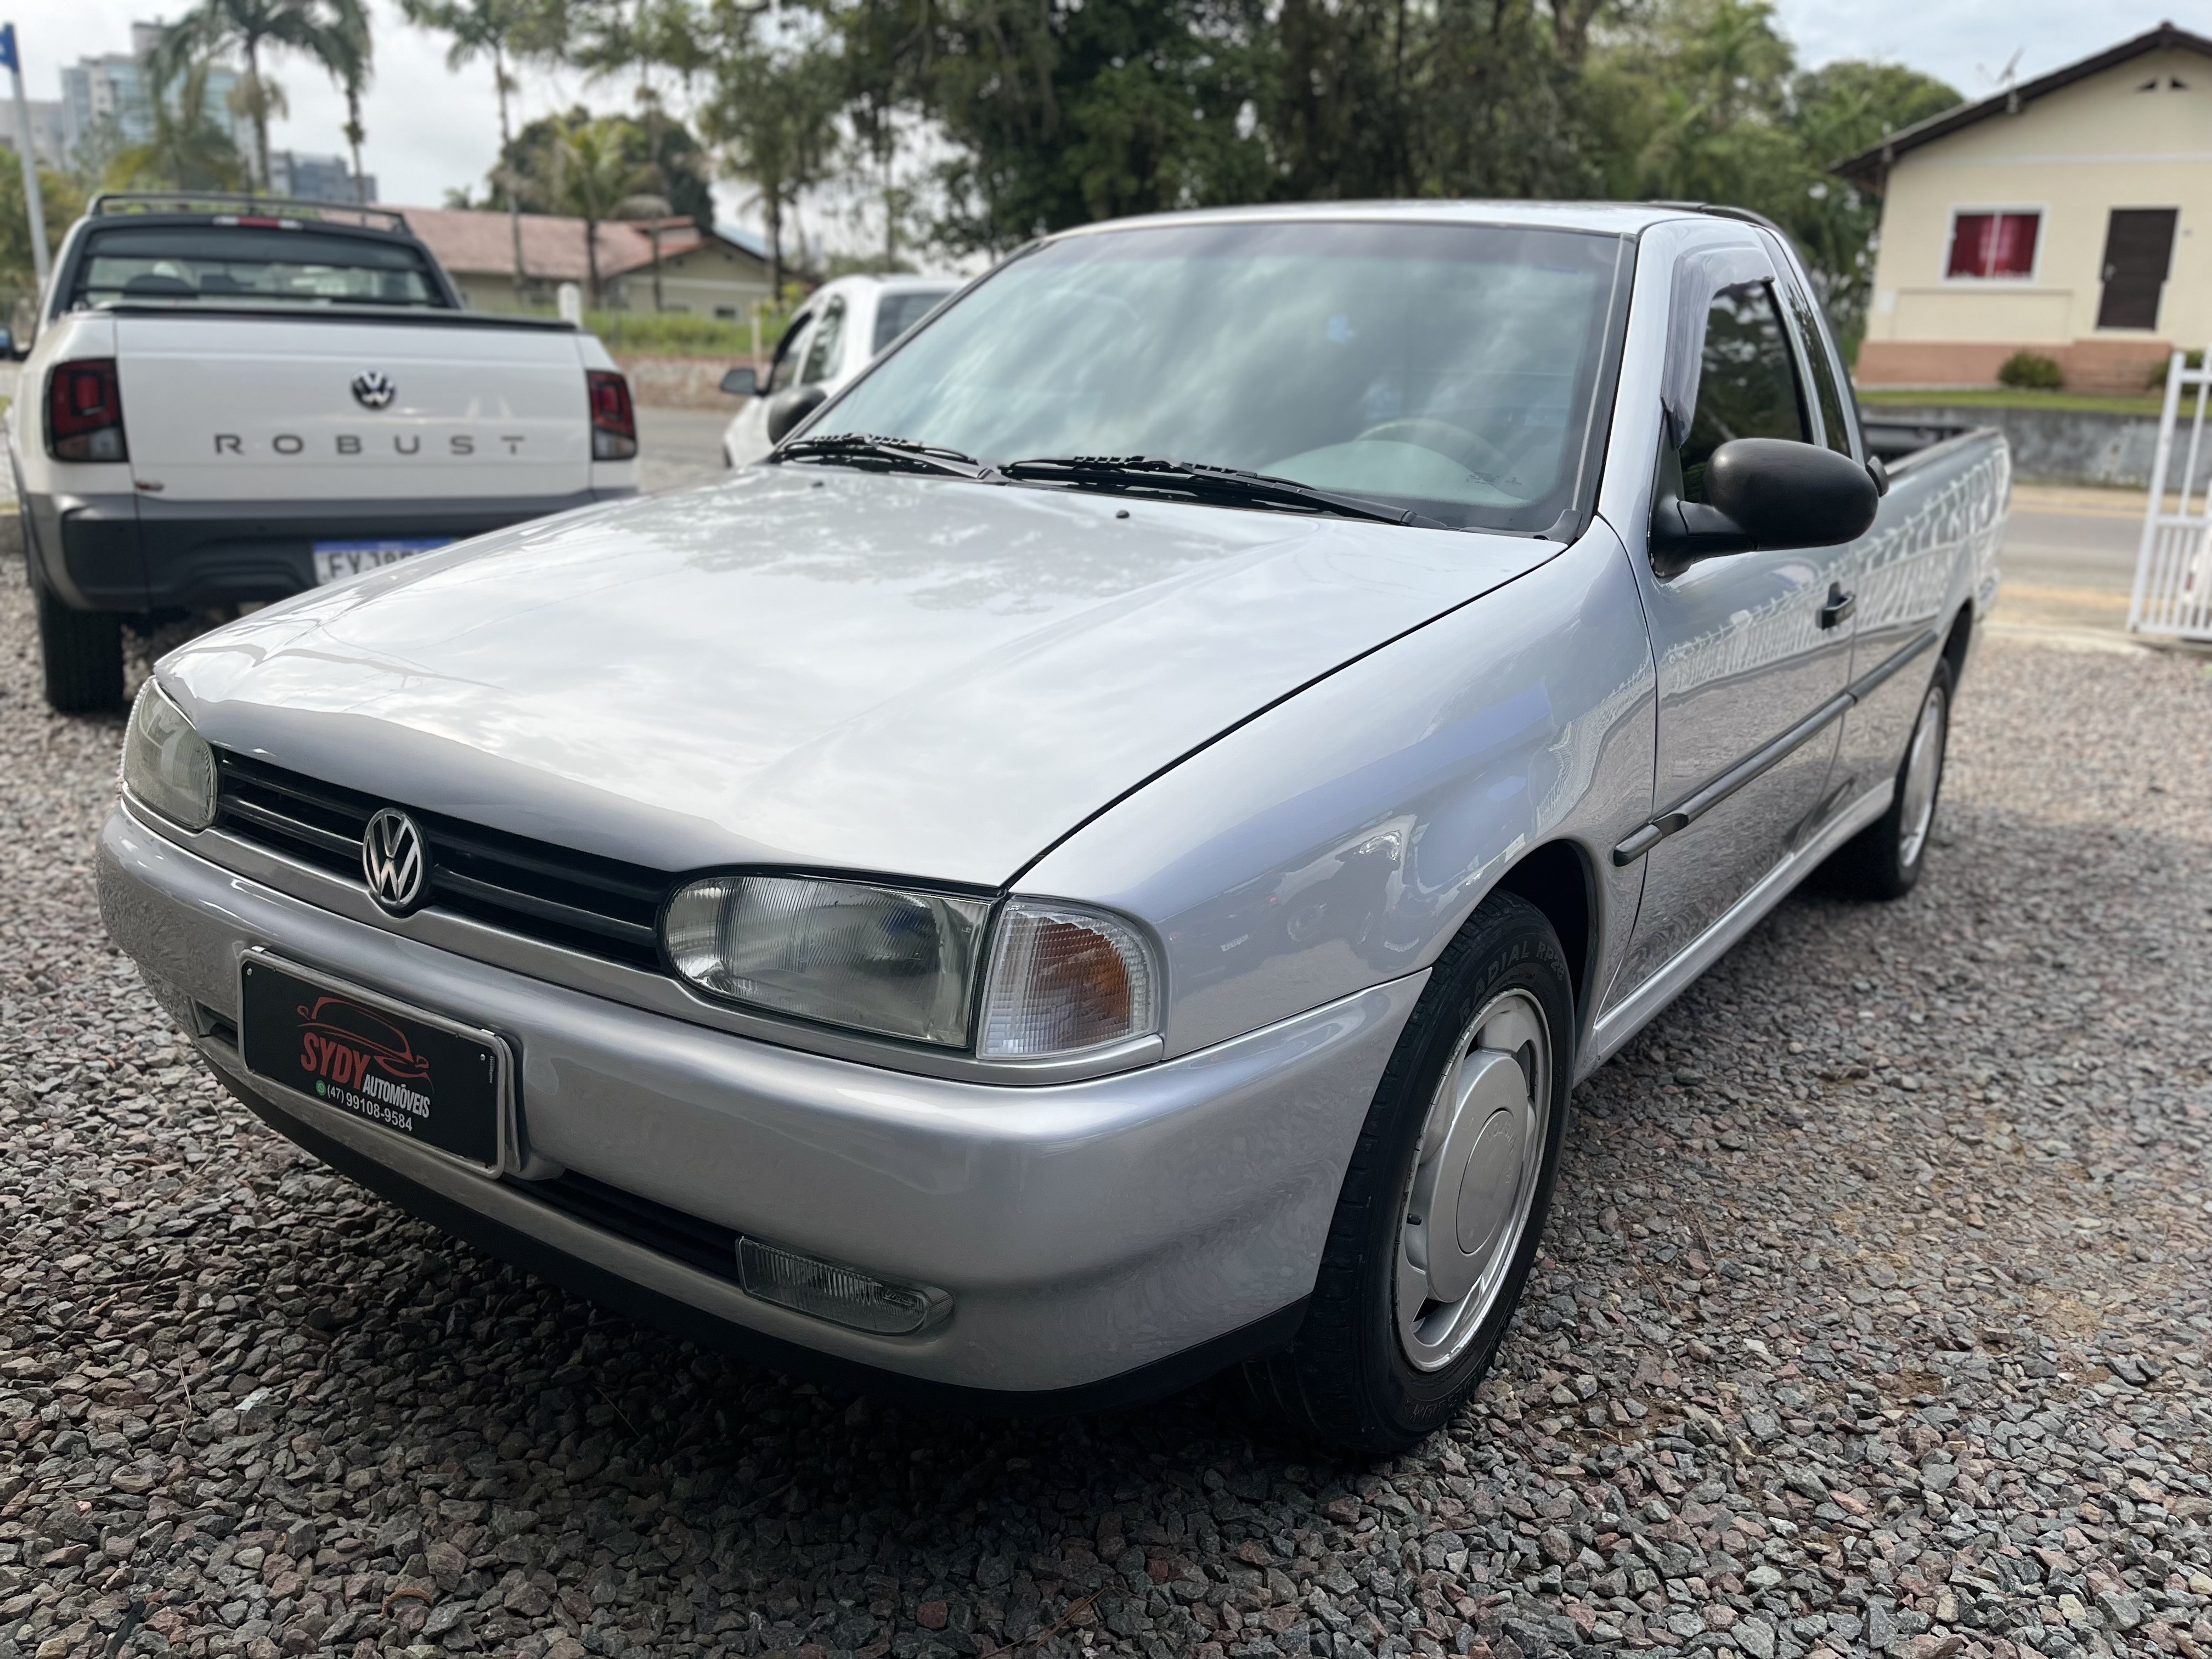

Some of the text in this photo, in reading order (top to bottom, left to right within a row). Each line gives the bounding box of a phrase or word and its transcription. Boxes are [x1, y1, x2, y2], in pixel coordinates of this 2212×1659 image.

[214, 434, 526, 455] ROBUST
[363, 808, 423, 907] VW
[1458, 940, 1530, 1027] RADIAL
[301, 1032, 371, 1090] SYDY
[362, 1074, 431, 1118] AUTOMÓVEIS
